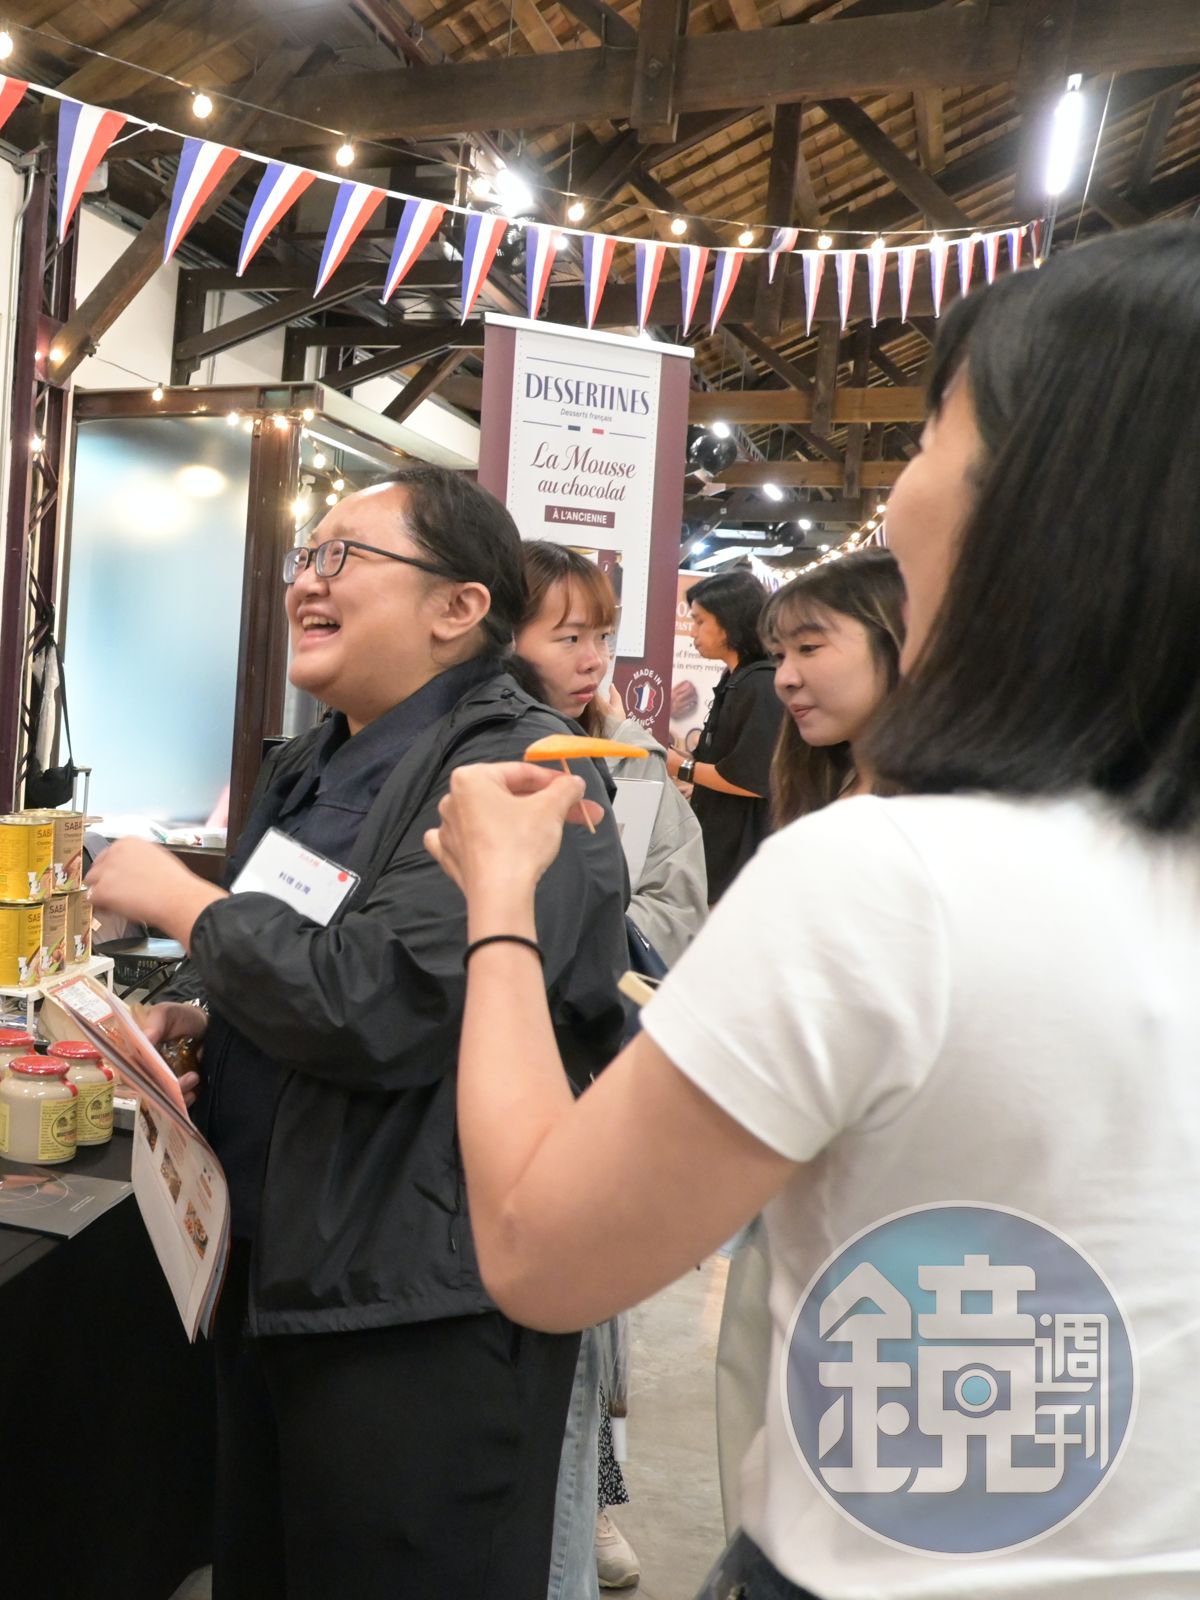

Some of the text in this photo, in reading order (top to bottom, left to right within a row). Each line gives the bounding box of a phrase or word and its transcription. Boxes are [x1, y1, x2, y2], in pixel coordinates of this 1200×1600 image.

[524, 372, 650, 416] DESSERTINES
[560, 408, 588, 419] Desserts
[530, 441, 638, 479] La Mousse
[538, 475, 626, 502] au chocolat
[561, 510, 607, 524] L'ANCIENNE
[633, 668, 662, 686] MADE IN
